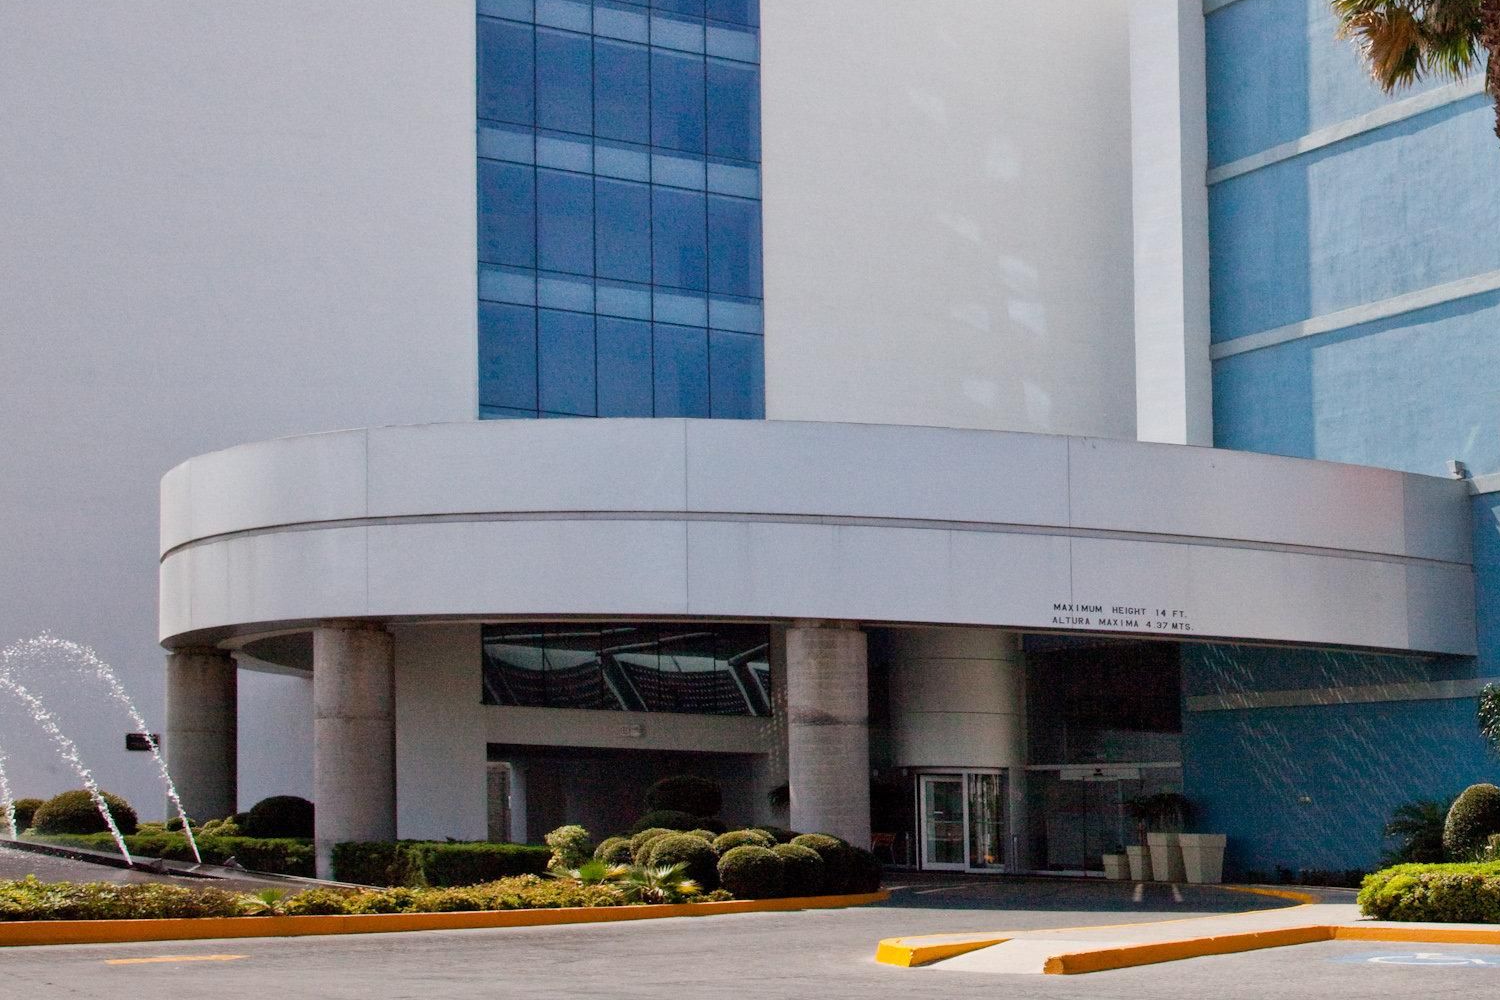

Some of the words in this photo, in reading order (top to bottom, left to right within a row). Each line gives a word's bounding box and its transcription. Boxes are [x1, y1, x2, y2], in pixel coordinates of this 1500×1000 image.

[1053, 603, 1102, 613] MAXIMUM
[1112, 606, 1146, 616] HEIGHT
[1155, 609, 1166, 617] 14
[1172, 610, 1187, 618] FT.
[1052, 616, 1090, 625] ALTURA
[1099, 618, 1139, 628] MAXIMA
[1172, 622, 1194, 631] MTS.
